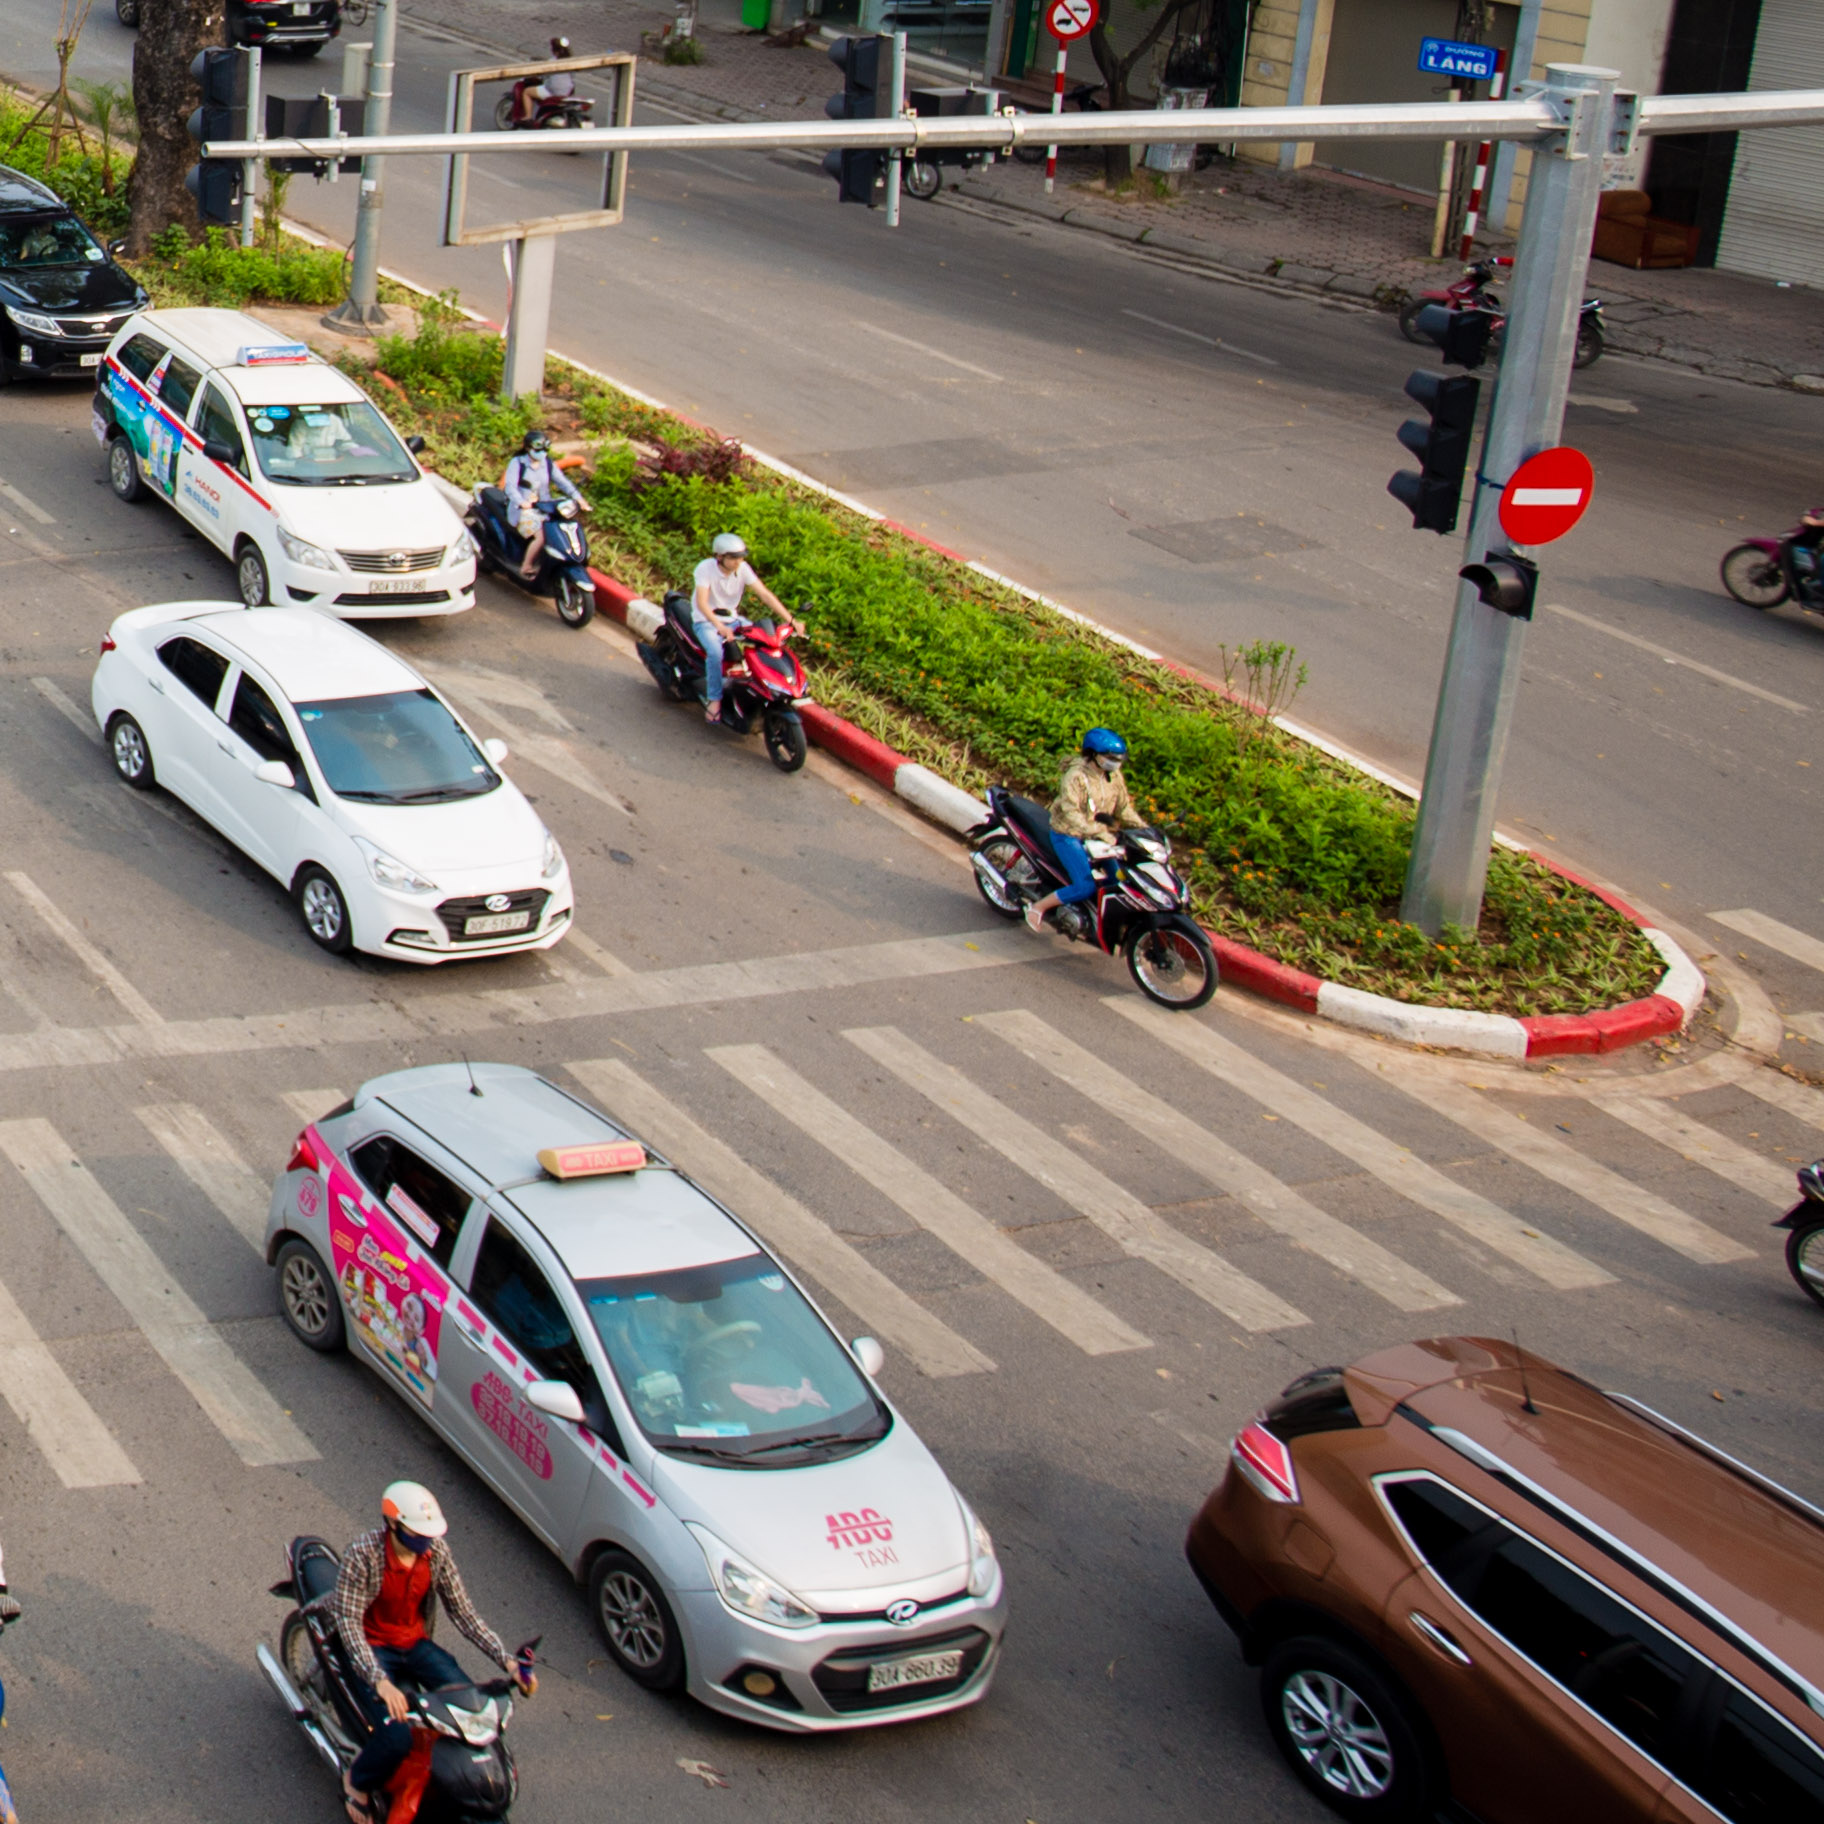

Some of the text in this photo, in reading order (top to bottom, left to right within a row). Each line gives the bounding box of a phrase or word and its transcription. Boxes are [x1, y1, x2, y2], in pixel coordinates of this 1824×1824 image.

[1427, 55, 1488, 76] LÁNG
[583, 1151, 618, 1168] TAXI
[517, 1397, 549, 1439] TAXI
[824, 1507, 893, 1550] ABC
[853, 1546, 900, 1569] TAXI
